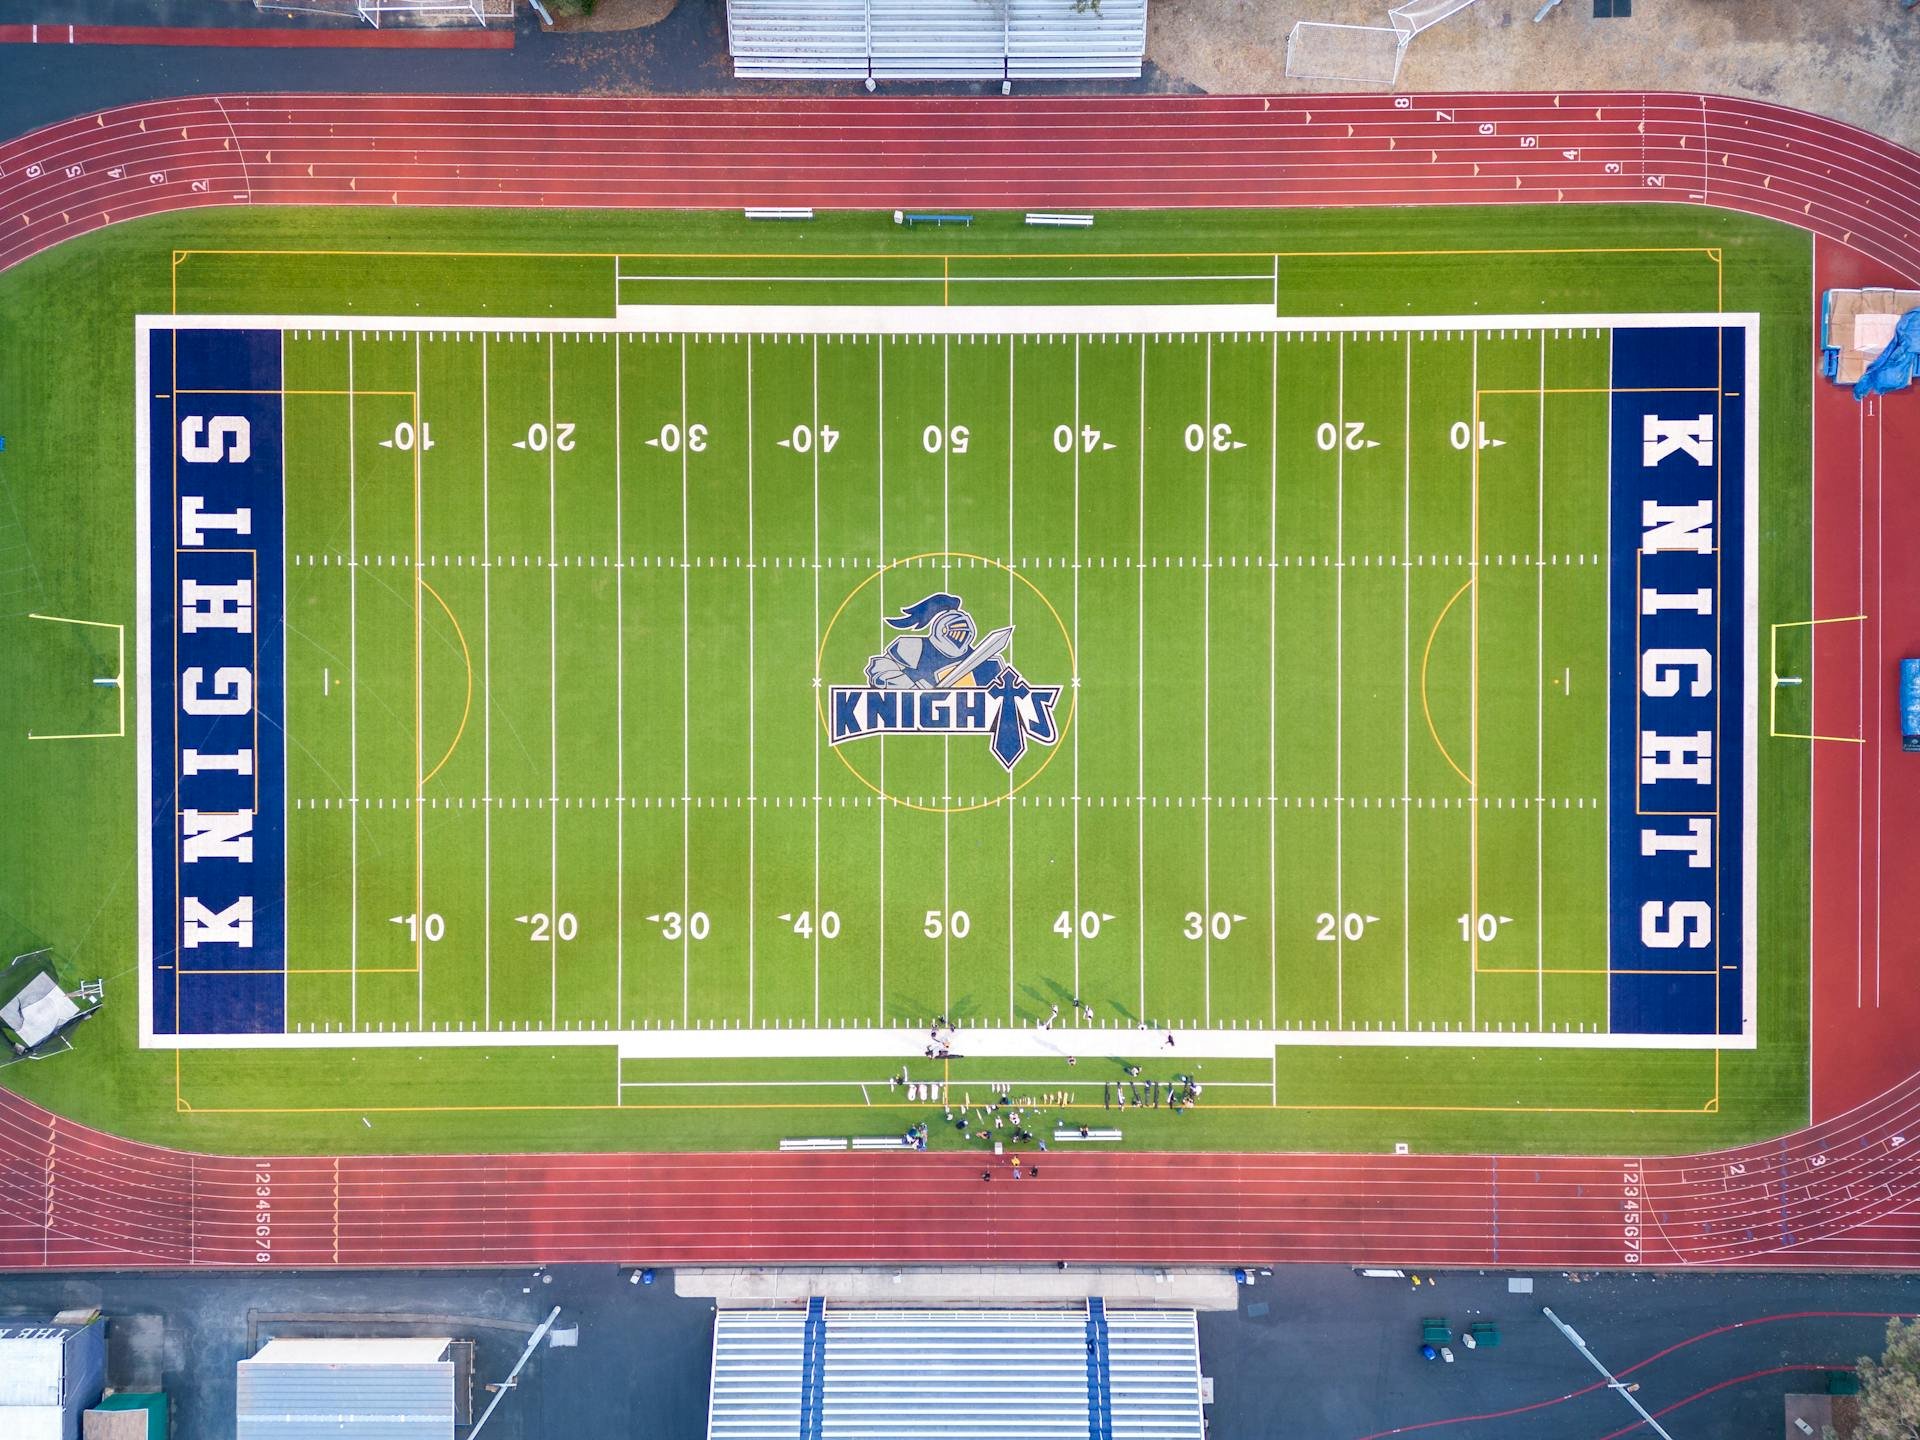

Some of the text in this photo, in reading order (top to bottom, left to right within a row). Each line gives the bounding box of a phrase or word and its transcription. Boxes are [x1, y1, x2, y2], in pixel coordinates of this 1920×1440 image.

[1395, 98, 1409, 107] 8
[1437, 111, 1451, 121] 7
[1479, 124, 1493, 135] 6
[1521, 136, 1535, 147] 5
[1563, 150, 1577, 160] 4
[1605, 163, 1619, 173] 3
[26, 165, 41, 178] 6
[65, 165, 81, 178] 5
[107, 168, 122, 178] 4
[149, 173, 164, 184] 3
[1647, 176, 1662, 186] 2
[191, 181, 207, 192] 2
[394, 422, 434, 451] 10
[528, 423, 576, 451] 20
[660, 424, 708, 452] 30
[792, 424, 839, 452] 40
[923, 424, 969, 453] 50
[1054, 424, 1100, 453] 40
[1184, 424, 1232, 452] 30
[1317, 422, 1365, 450] 20
[1450, 421, 1490, 450] 10
[181, 415, 254, 948] KNIGHTS
[1642, 414, 1713, 948] KNIGHTS
[834, 667, 1057, 766] KNIGHTS
[404, 913, 444, 941] 10
[530, 913, 577, 941] 20
[662, 912, 709, 939] 30
[793, 911, 840, 939] 40
[924, 911, 970, 939] 50
[1053, 911, 1100, 939] 40
[1183, 911, 1231, 940] 30
[1316, 913, 1364, 941] 20
[1458, 913, 1497, 941] 10
[1891, 1136, 1906, 1147] 4
[1730, 1164, 1746, 1175] 2
[1812, 1155, 1826, 1167] 3
